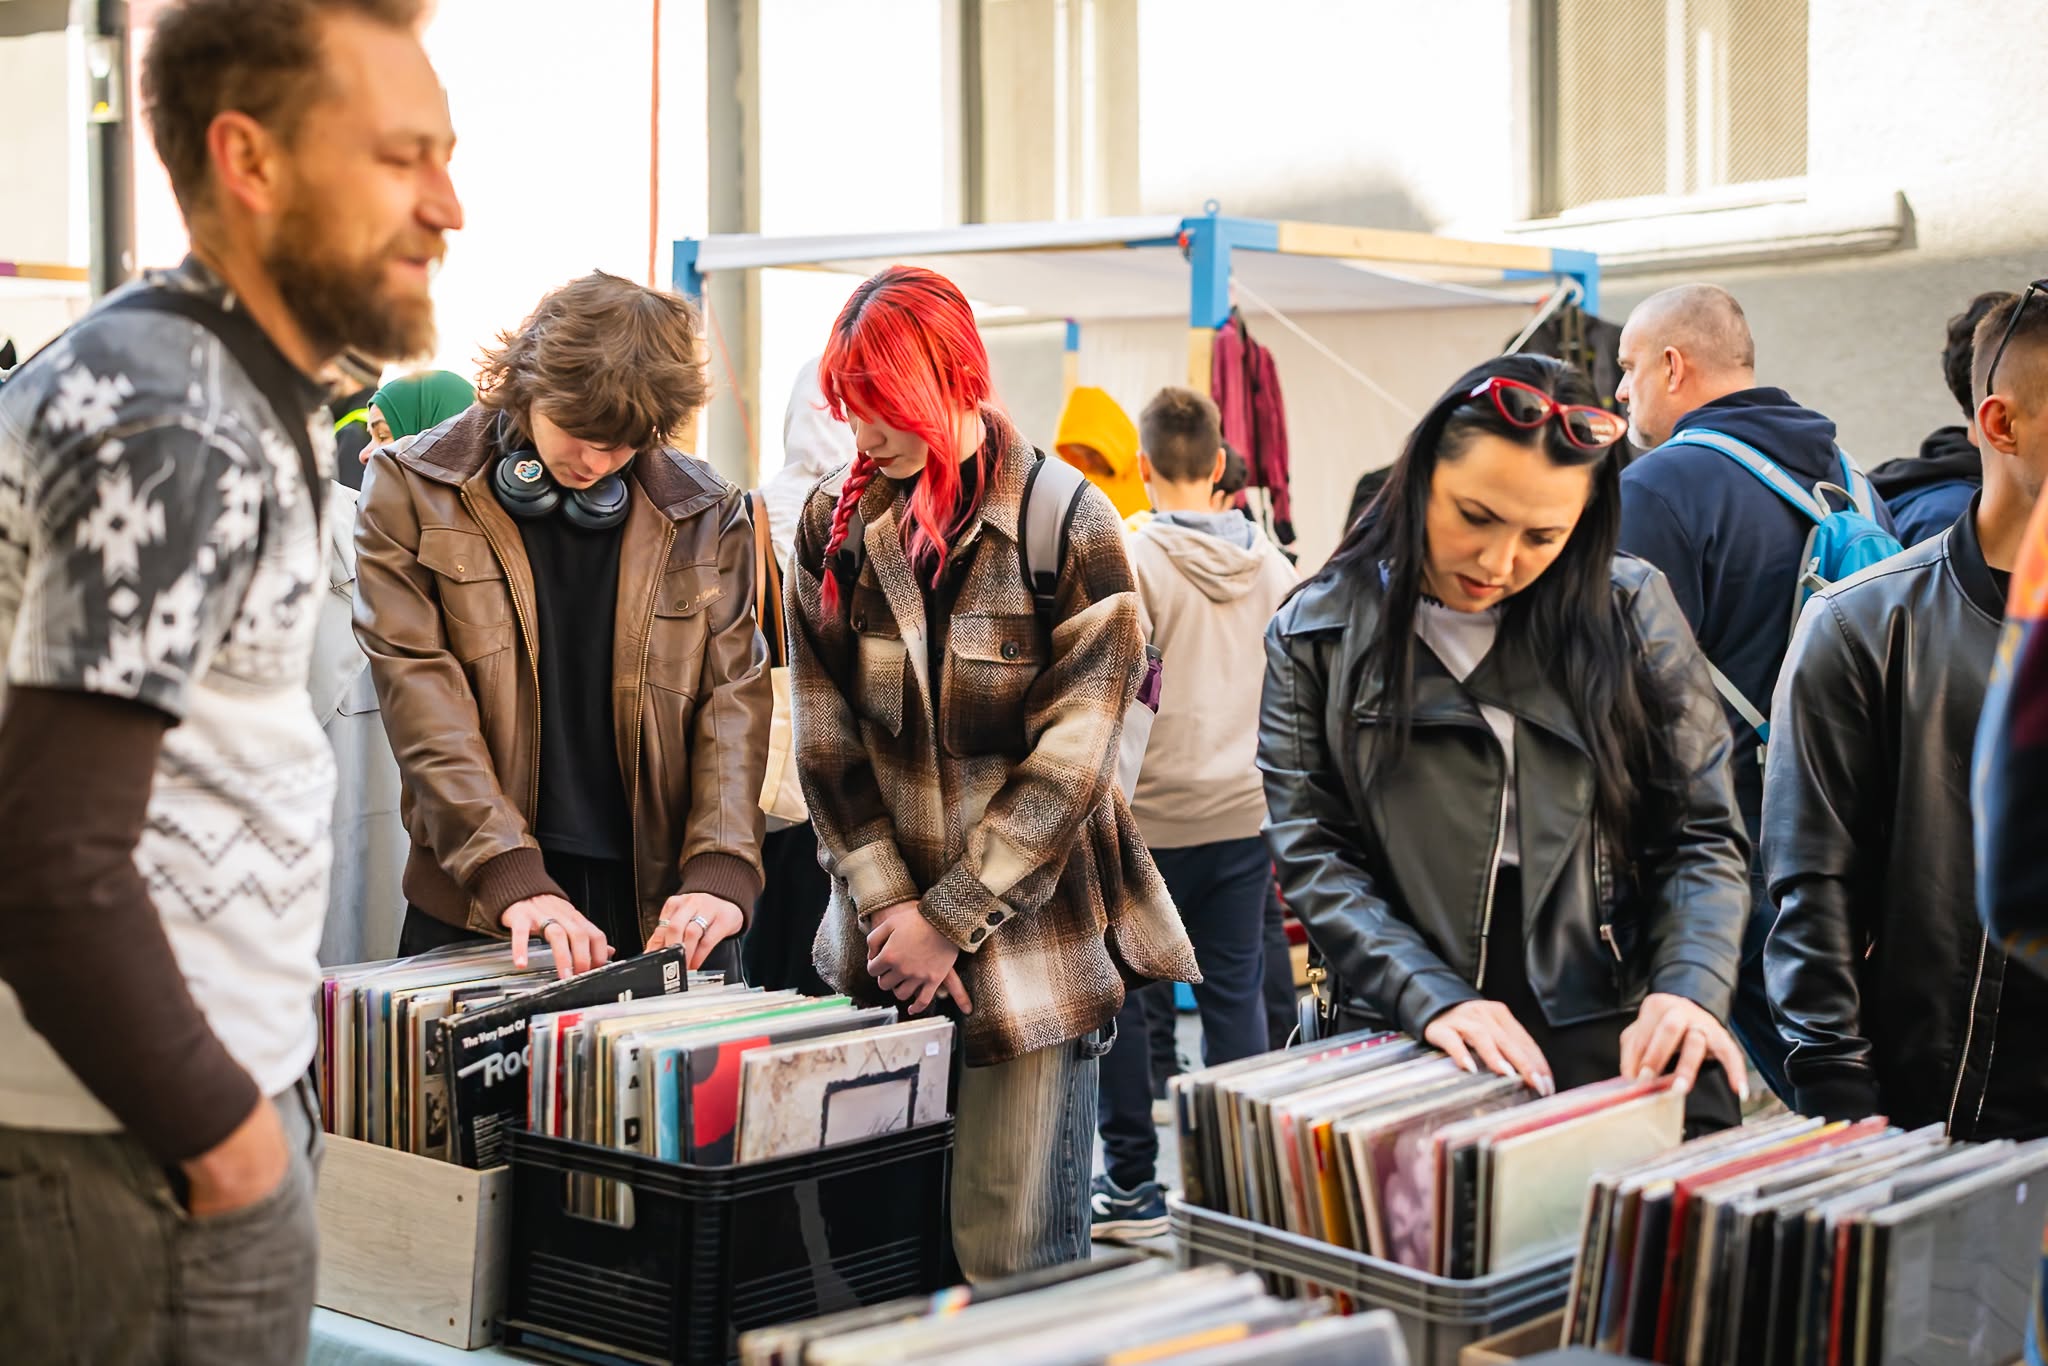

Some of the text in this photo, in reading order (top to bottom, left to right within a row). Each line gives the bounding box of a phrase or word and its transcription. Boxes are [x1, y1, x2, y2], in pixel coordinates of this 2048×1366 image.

[462, 1018, 526, 1049] The Very Best Of
